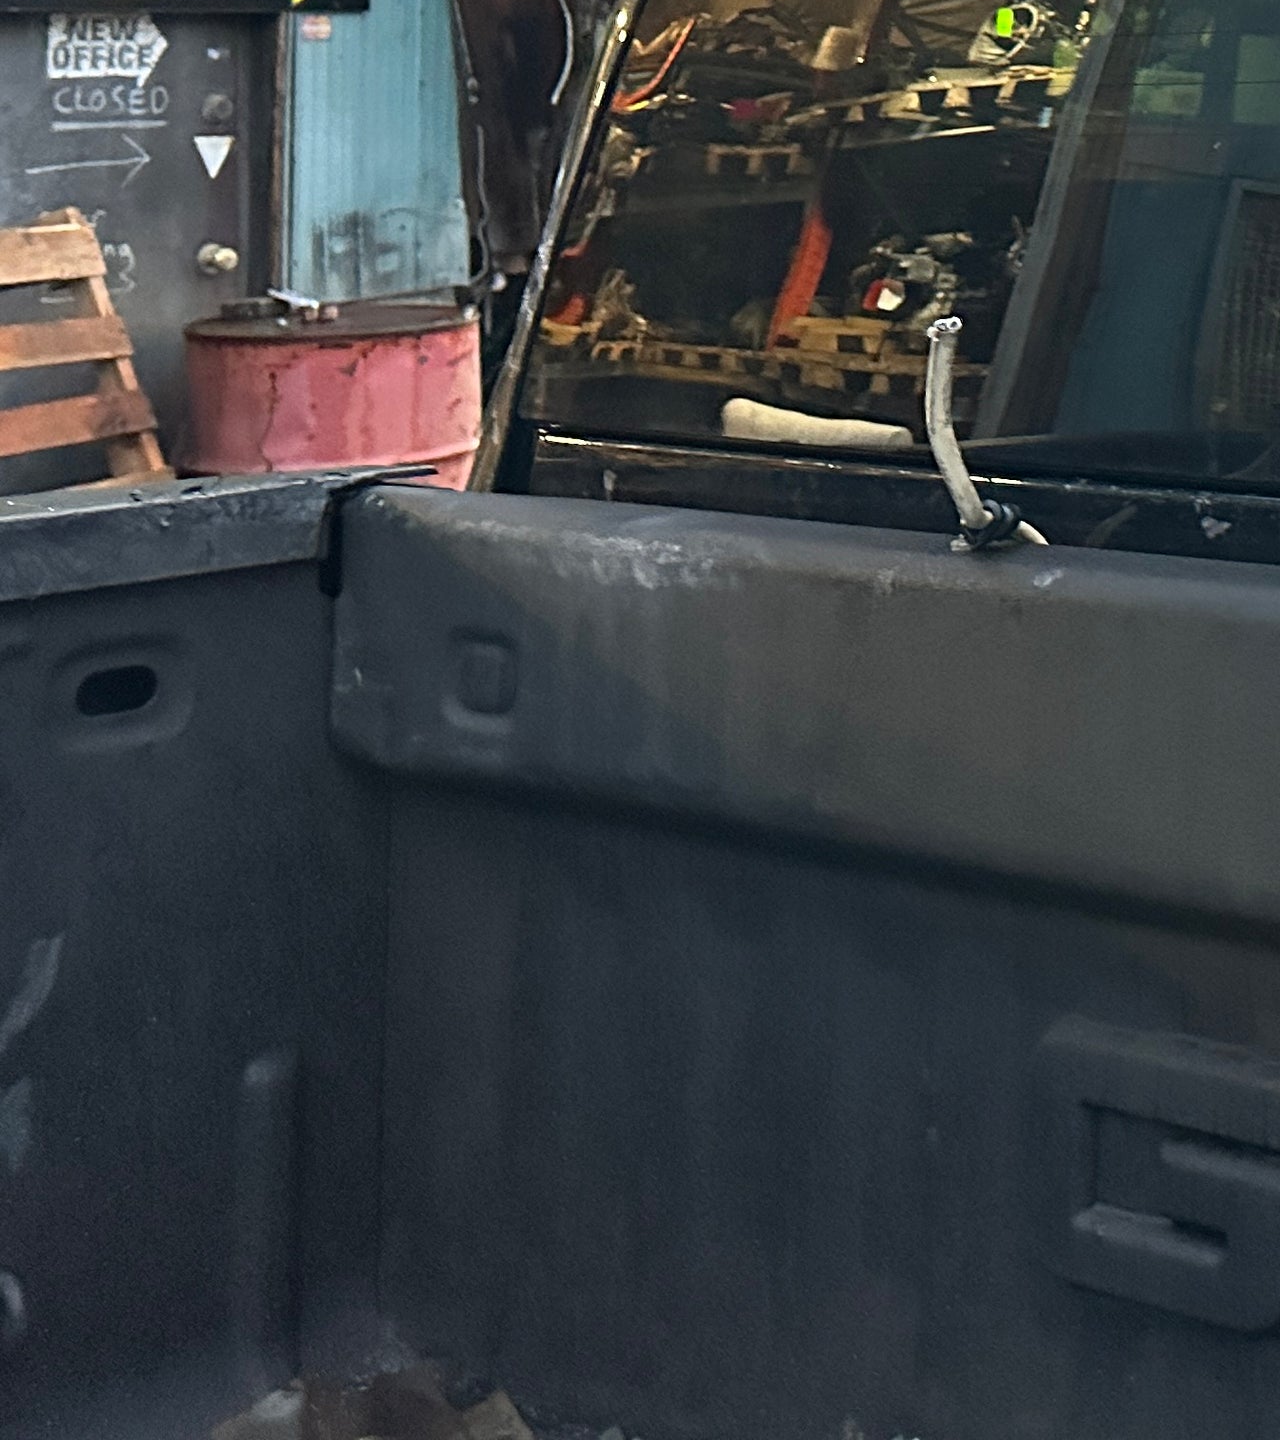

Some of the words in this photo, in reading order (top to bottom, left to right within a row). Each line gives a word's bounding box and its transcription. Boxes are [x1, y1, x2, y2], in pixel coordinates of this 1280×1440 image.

[67, 17, 137, 41] NEW
[53, 43, 154, 71] OFFICE
[53, 85, 169, 115] CLOSED
